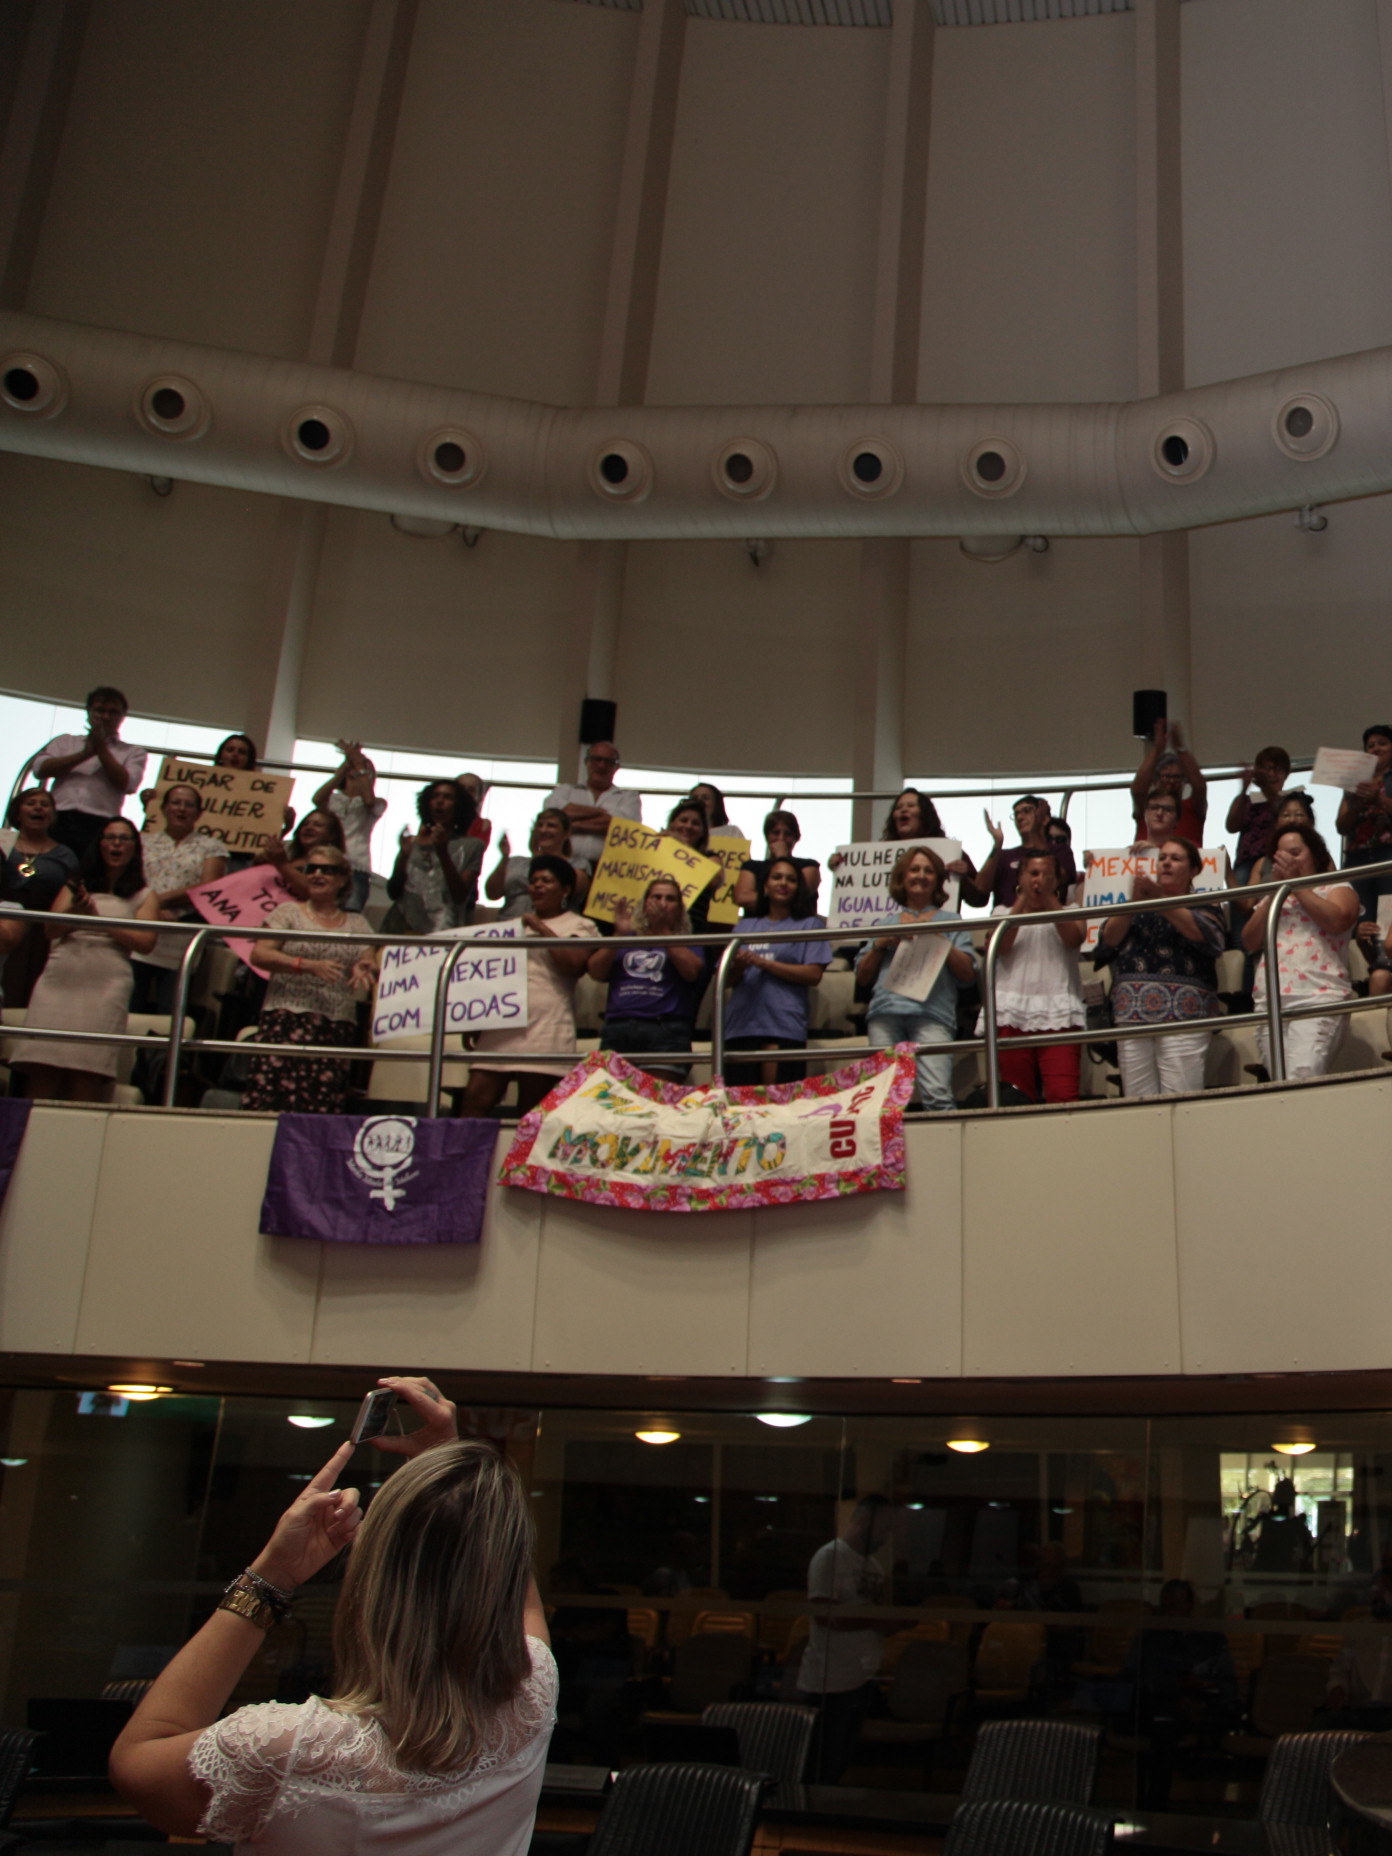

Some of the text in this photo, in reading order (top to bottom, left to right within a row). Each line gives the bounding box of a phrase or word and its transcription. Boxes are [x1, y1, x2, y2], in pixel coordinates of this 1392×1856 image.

[163, 764, 278, 794] LUGAR DE
[199, 797, 265, 819] ULHER
[609, 825, 702, 868] BASTA DE
[835, 872, 893, 889] NA LUT
[200, 889, 242, 923] ANA
[380, 974, 420, 999] UMA
[373, 992, 521, 1036] COM ODAS
[548, 1125, 787, 1178] MOVIMENTO
